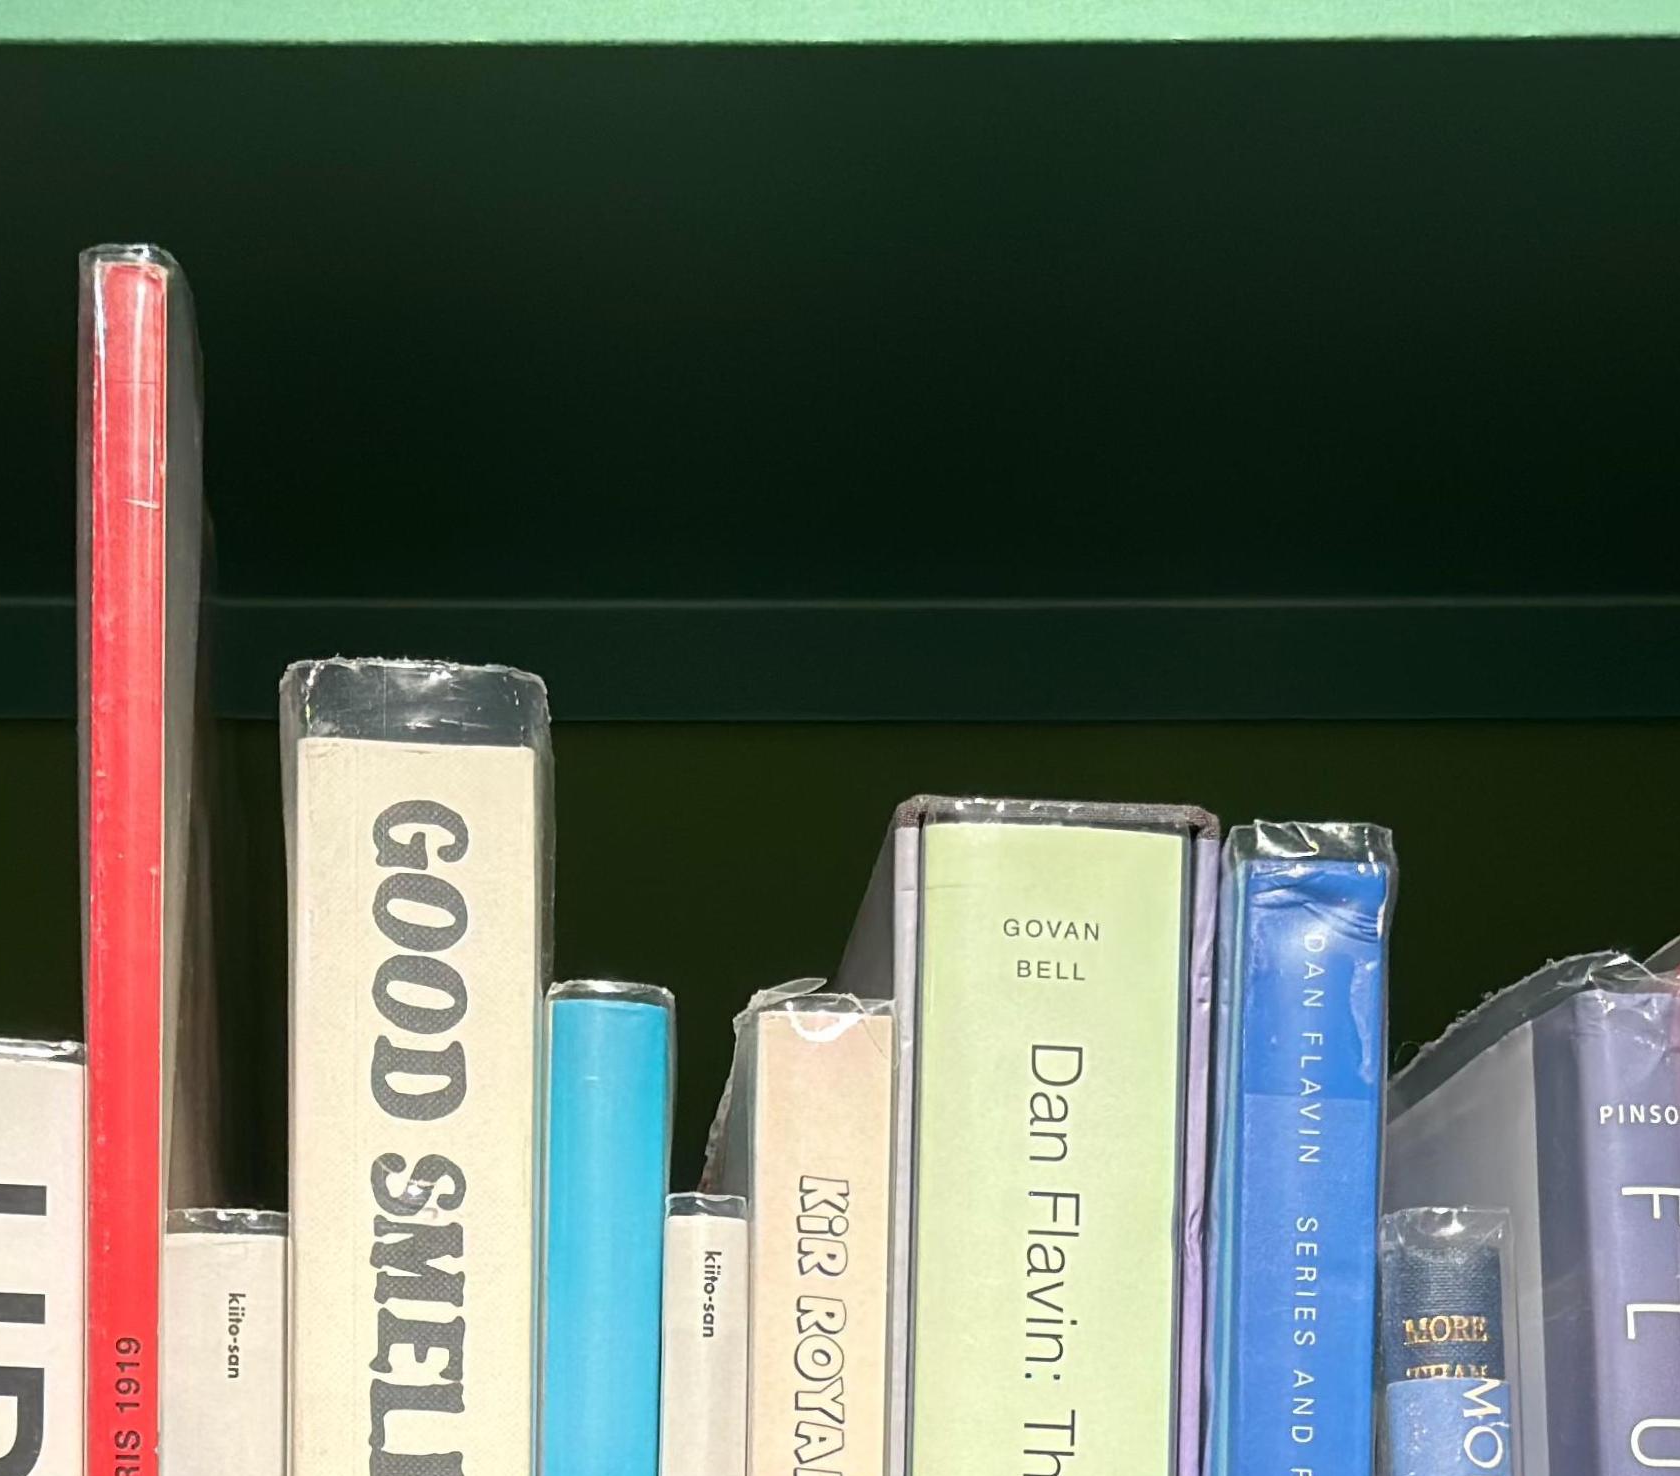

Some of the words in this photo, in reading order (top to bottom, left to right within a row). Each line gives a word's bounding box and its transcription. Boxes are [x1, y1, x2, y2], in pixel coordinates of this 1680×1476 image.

[369, 800, 469, 1121] GOOD
[1004, 919, 1098, 940] GOVAN
[1017, 960, 1085, 980] BELL
[1302, 933, 1324, 1009] DAN
[1030, 1045, 1083, 1161] Dan
[1298, 1032, 1323, 1163] FLAVIN
[703, 1251, 722, 1337] kiito-san
[1025, 1191, 1080, 1380] Flavin:
[1293, 1217, 1318, 1346] SERIES
[116, 1336, 143, 1420] 1919
[228, 1293, 246, 1378] kiito-san
[1291, 1370, 1314, 1443] AND
